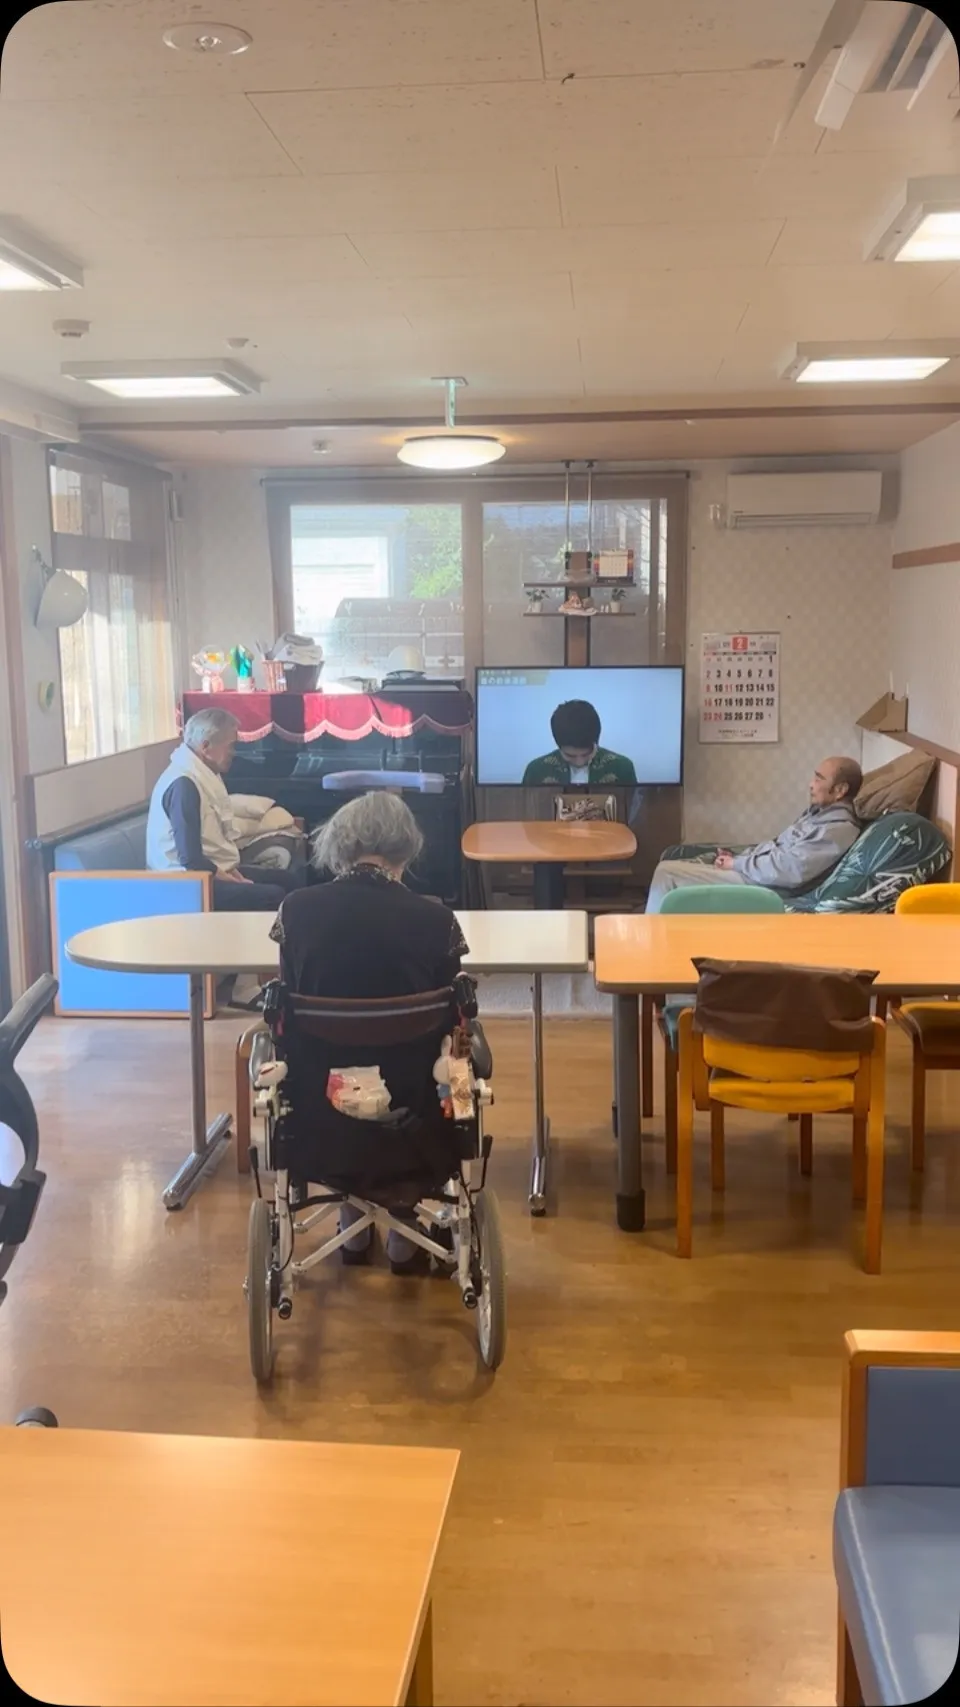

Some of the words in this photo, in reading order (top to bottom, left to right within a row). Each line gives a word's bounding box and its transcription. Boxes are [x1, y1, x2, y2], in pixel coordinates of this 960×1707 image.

[737, 638, 744, 649] 2
[714, 684, 723, 692] 10
[725, 684, 732, 692] 11
[735, 684, 743, 692] 12
[746, 684, 754, 692] 13
[756, 684, 764, 692] 14
[766, 684, 775, 692] 15
[714, 698, 722, 706] 17
[724, 698, 733, 706] 18
[735, 698, 743, 706] 19
[745, 698, 753, 706] 20
[755, 698, 763, 706] 21
[766, 698, 774, 706] 22
[703, 712, 712, 720] 23
[713, 712, 722, 720] 24
[724, 712, 732, 720] 25
[734, 712, 743, 720] 26
[745, 712, 753, 720] 27
[755, 712, 764, 720] 28
